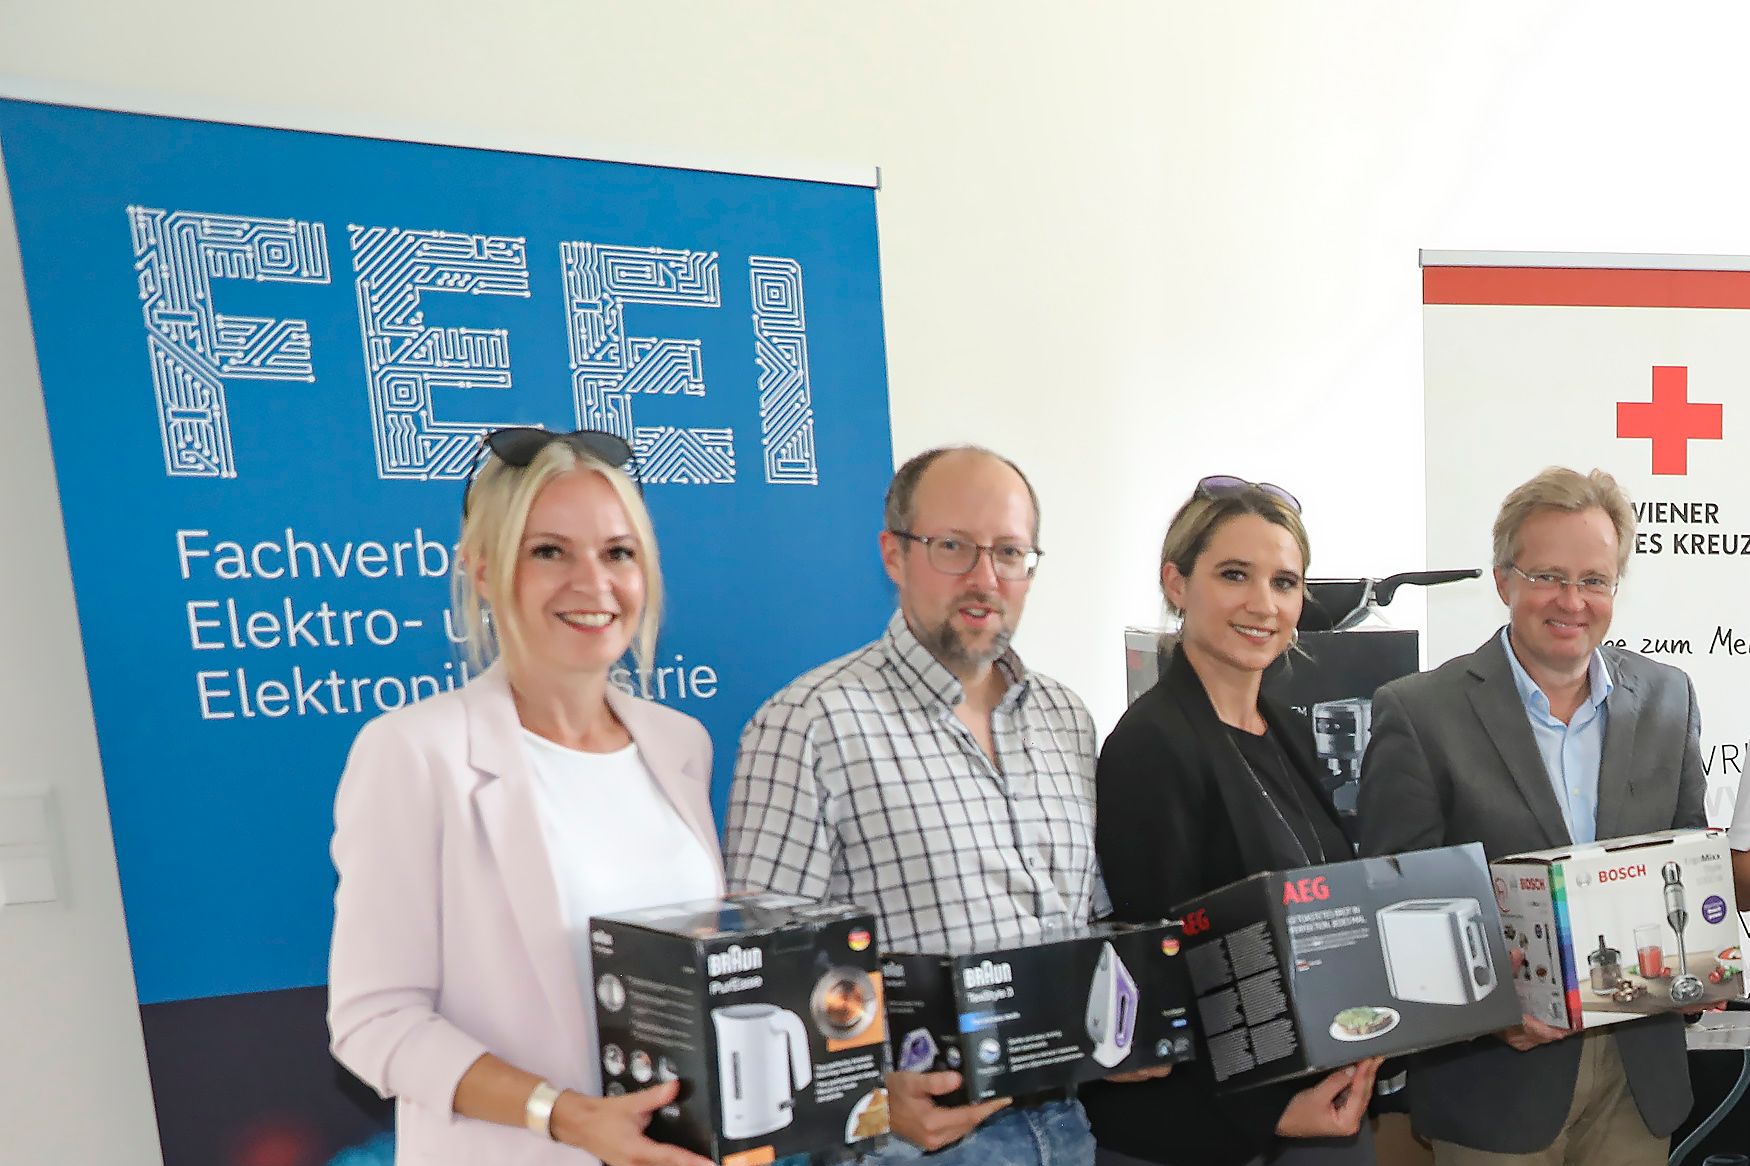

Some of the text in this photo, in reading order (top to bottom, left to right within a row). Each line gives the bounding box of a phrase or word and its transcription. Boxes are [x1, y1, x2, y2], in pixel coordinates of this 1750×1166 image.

[126, 203, 818, 486] FEEI
[176, 527, 460, 580] Fachverb
[186, 597, 424, 650] Elektro-
[1640, 638, 1693, 655] zum
[1519, 877, 1546, 892] BOSCH
[1599, 864, 1647, 884] BOSCH
[1282, 875, 1331, 905] AEG
[707, 944, 763, 978] BRAUN
[962, 959, 1013, 989] BRAUN
